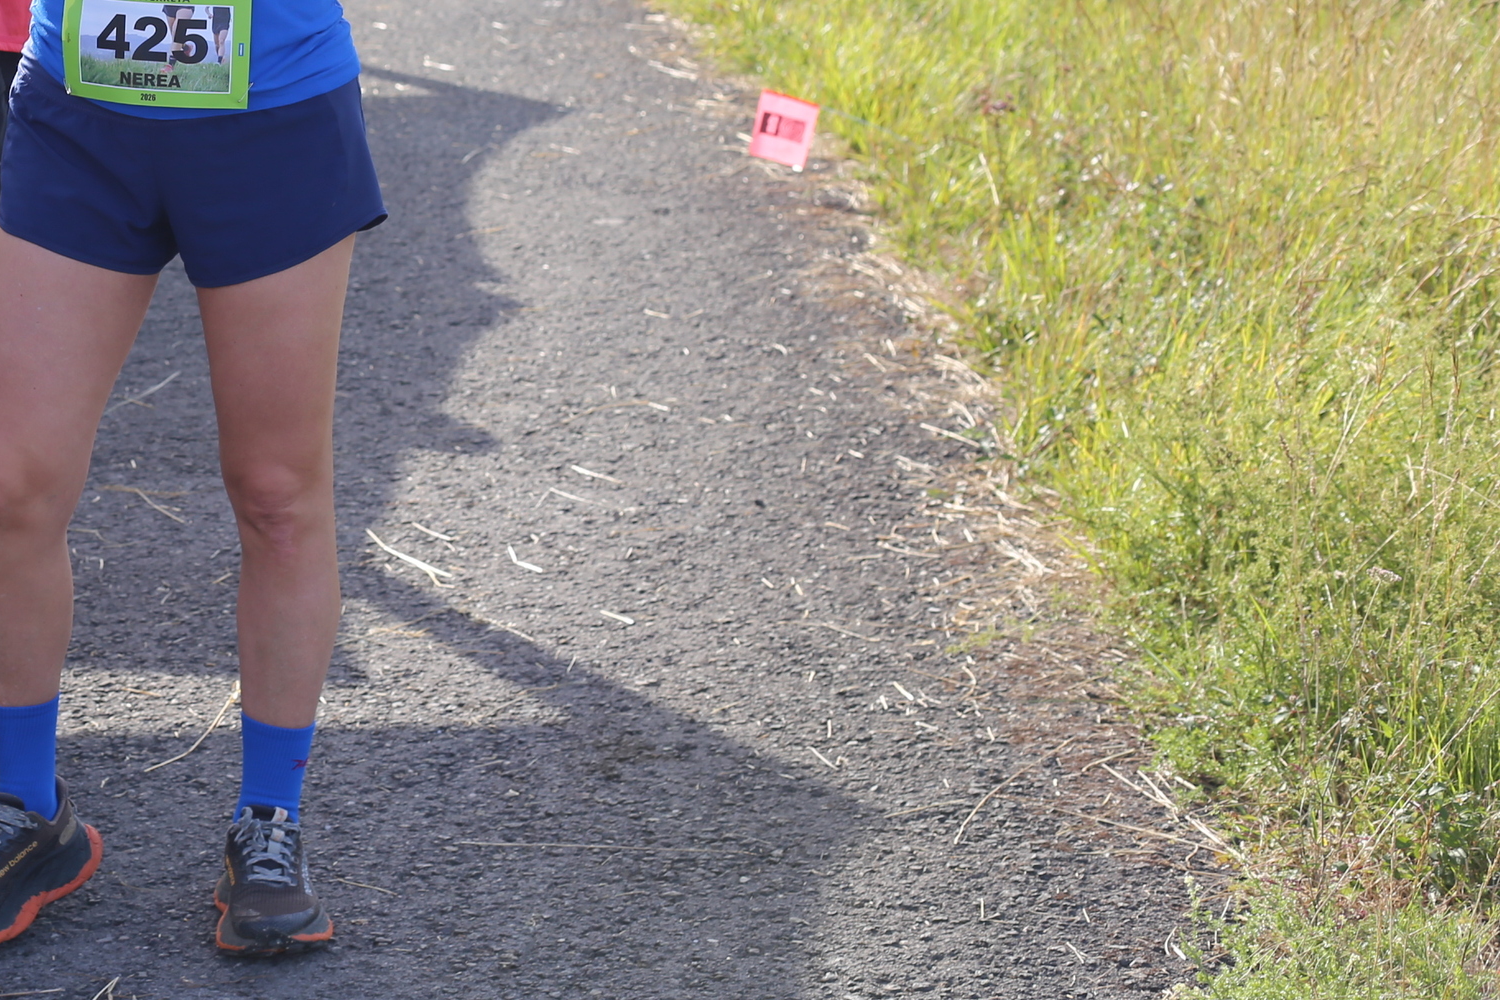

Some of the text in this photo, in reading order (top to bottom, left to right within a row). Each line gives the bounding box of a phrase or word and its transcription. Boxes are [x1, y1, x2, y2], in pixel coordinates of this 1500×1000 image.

[96, 13, 209, 65] 425
[119, 71, 181, 88] NEREA
[140, 93, 156, 102] 2026
[8, 841, 38, 867] balance
